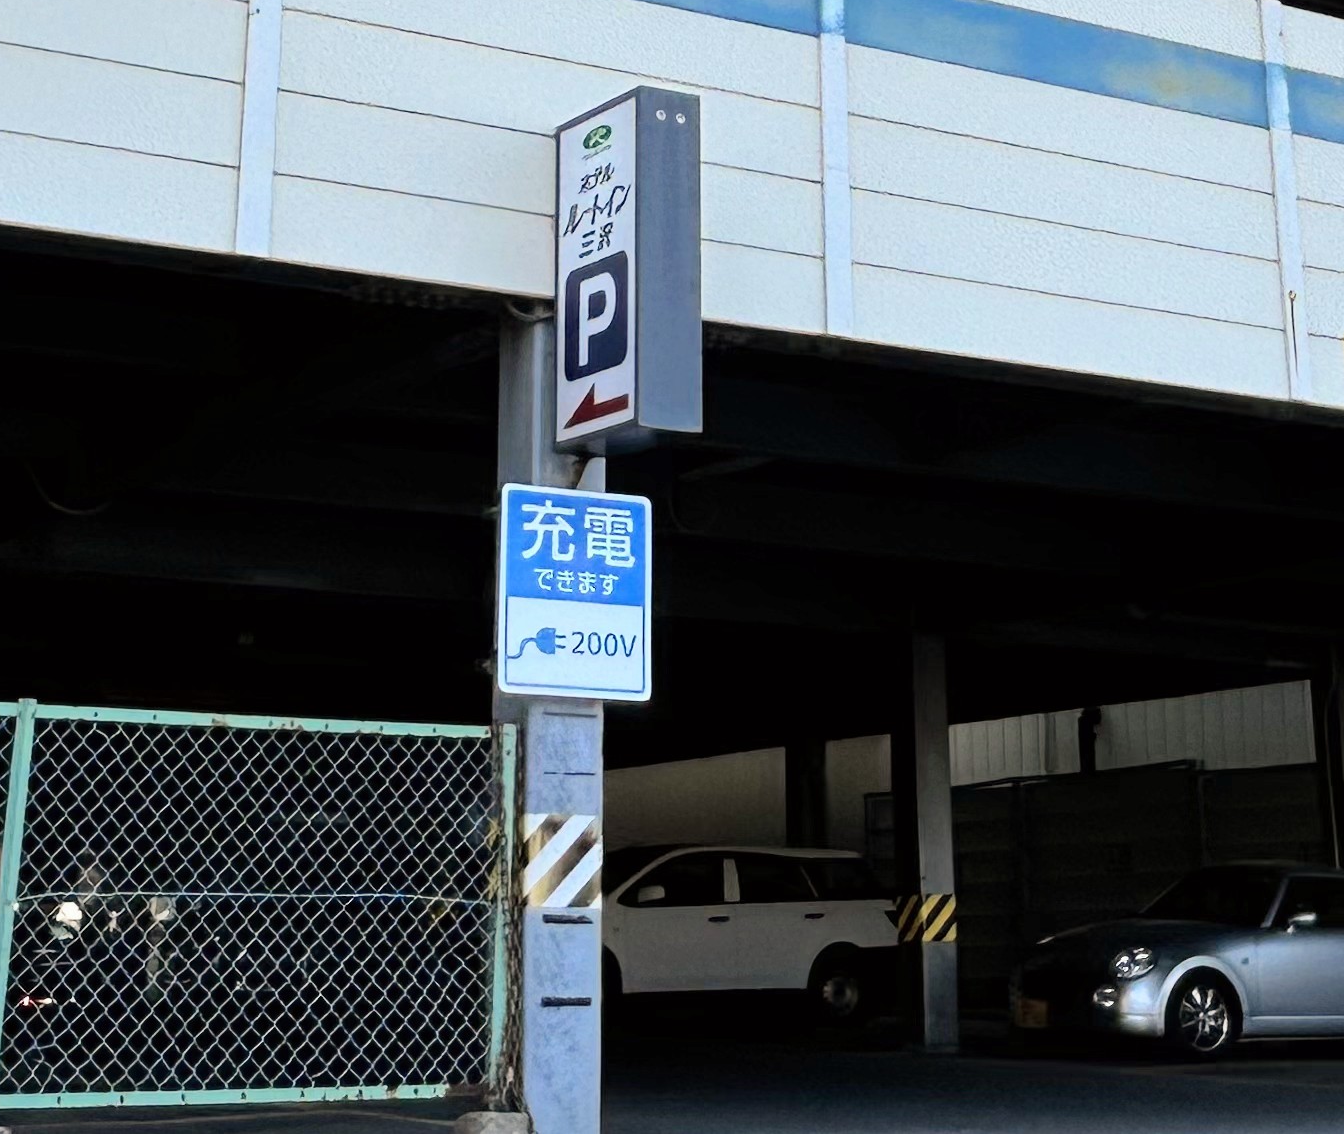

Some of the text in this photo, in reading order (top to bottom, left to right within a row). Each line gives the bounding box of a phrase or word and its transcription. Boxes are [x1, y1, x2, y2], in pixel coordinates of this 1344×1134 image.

[577, 162, 616, 195] ホテル
[562, 184, 632, 238] ルートイン
[578, 221, 614, 259] 三沢
[578, 287, 617, 367] P
[521, 499, 636, 568] 充電
[534, 568, 620, 596] できます
[571, 631, 637, 658] 200V
